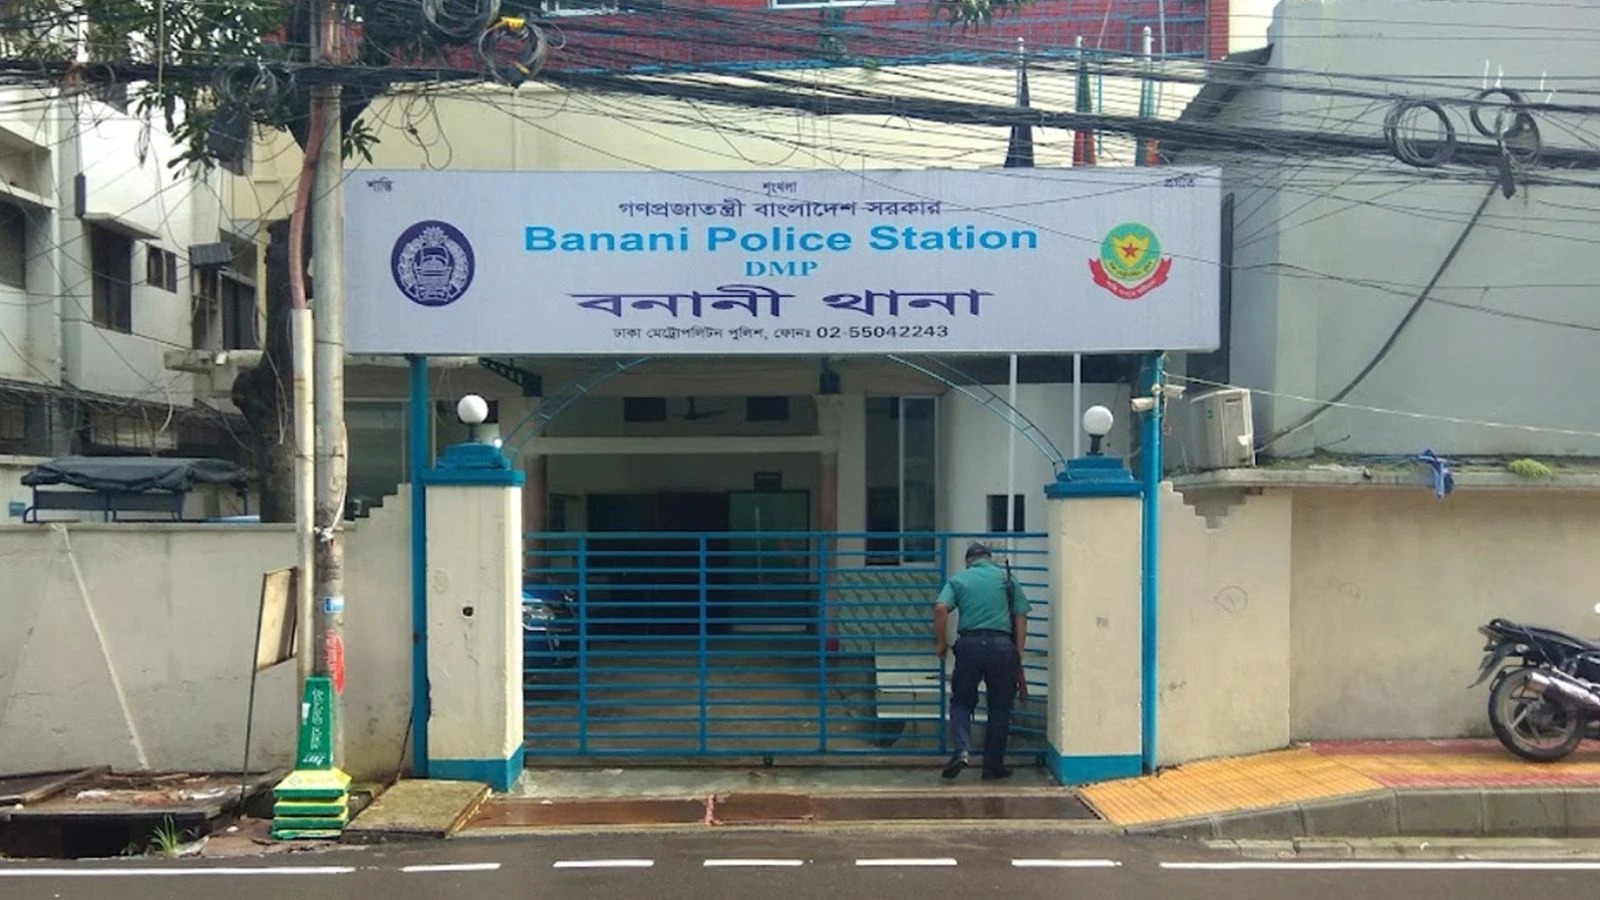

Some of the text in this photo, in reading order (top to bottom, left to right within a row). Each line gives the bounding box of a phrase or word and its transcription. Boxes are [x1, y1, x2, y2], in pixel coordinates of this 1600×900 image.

[618, 198, 941, 217] গণপ্রজাতন্ত্রী বাংলাদেশ সরকার
[525, 225, 1037, 251] Banani Police Station
[745, 261, 818, 276] DMP
[567, 284, 994, 317] বনানী থানা
[613, 327, 641, 339] ঢাকা
[646, 325, 723, 340] মেট্রোপলিটন
[728, 325, 768, 341] পুলিশ,
[816, 325, 949, 339] 02-55042243
